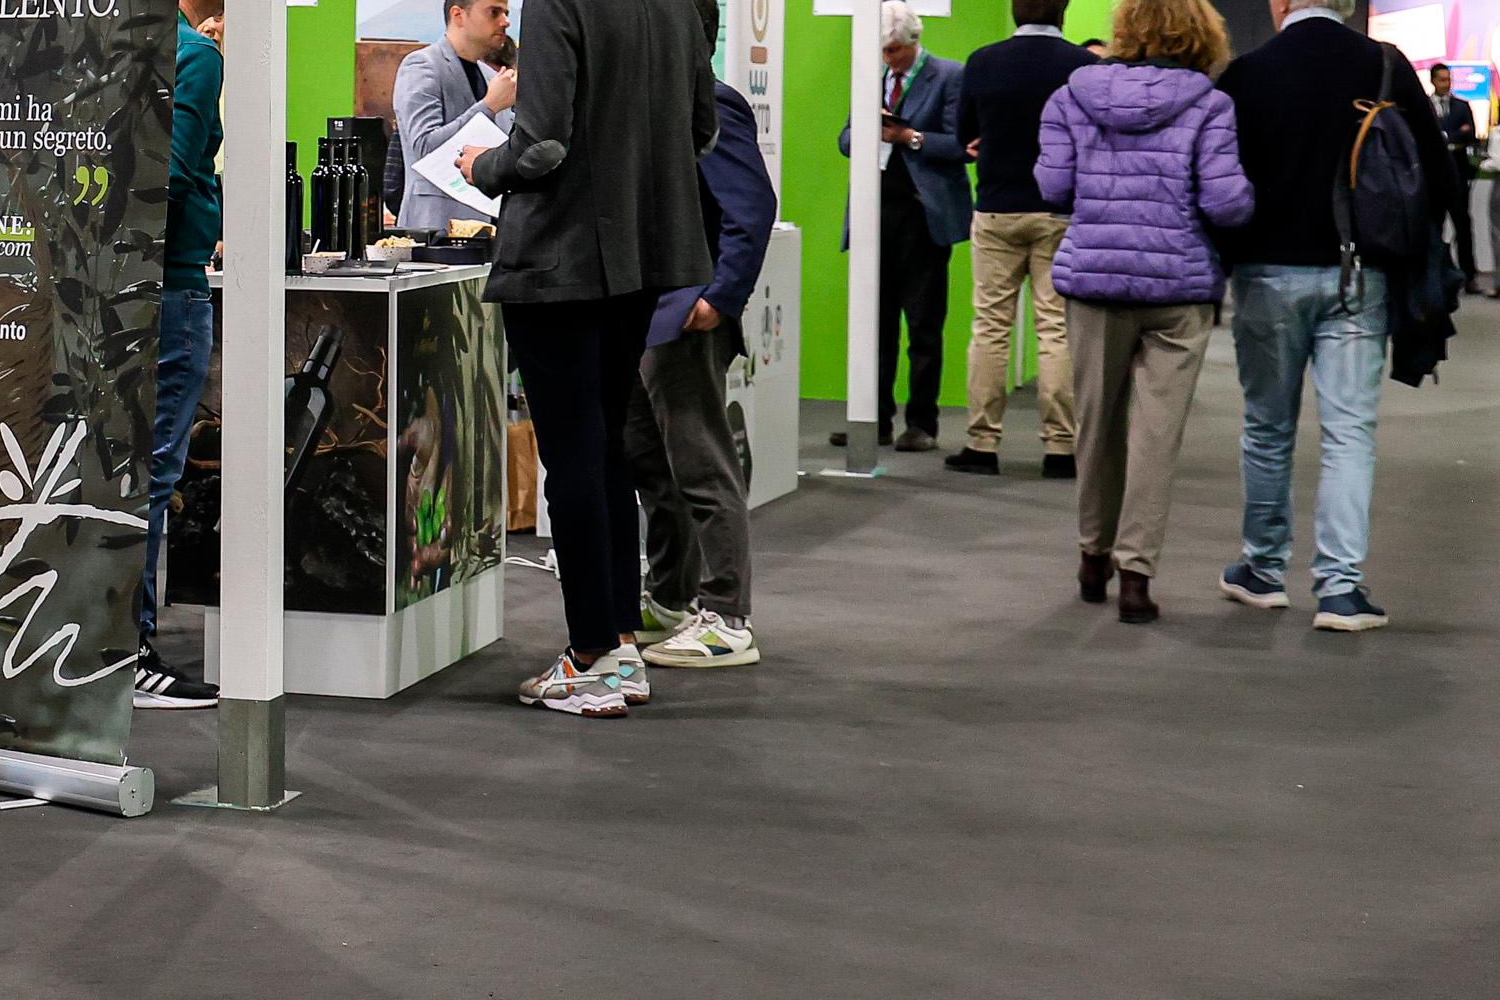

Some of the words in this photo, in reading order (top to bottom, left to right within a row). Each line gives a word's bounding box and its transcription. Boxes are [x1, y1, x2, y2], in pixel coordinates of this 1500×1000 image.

[26, 95, 52, 121] ha
[0, 130, 27, 150] un
[32, 127, 112, 156] segreto.
